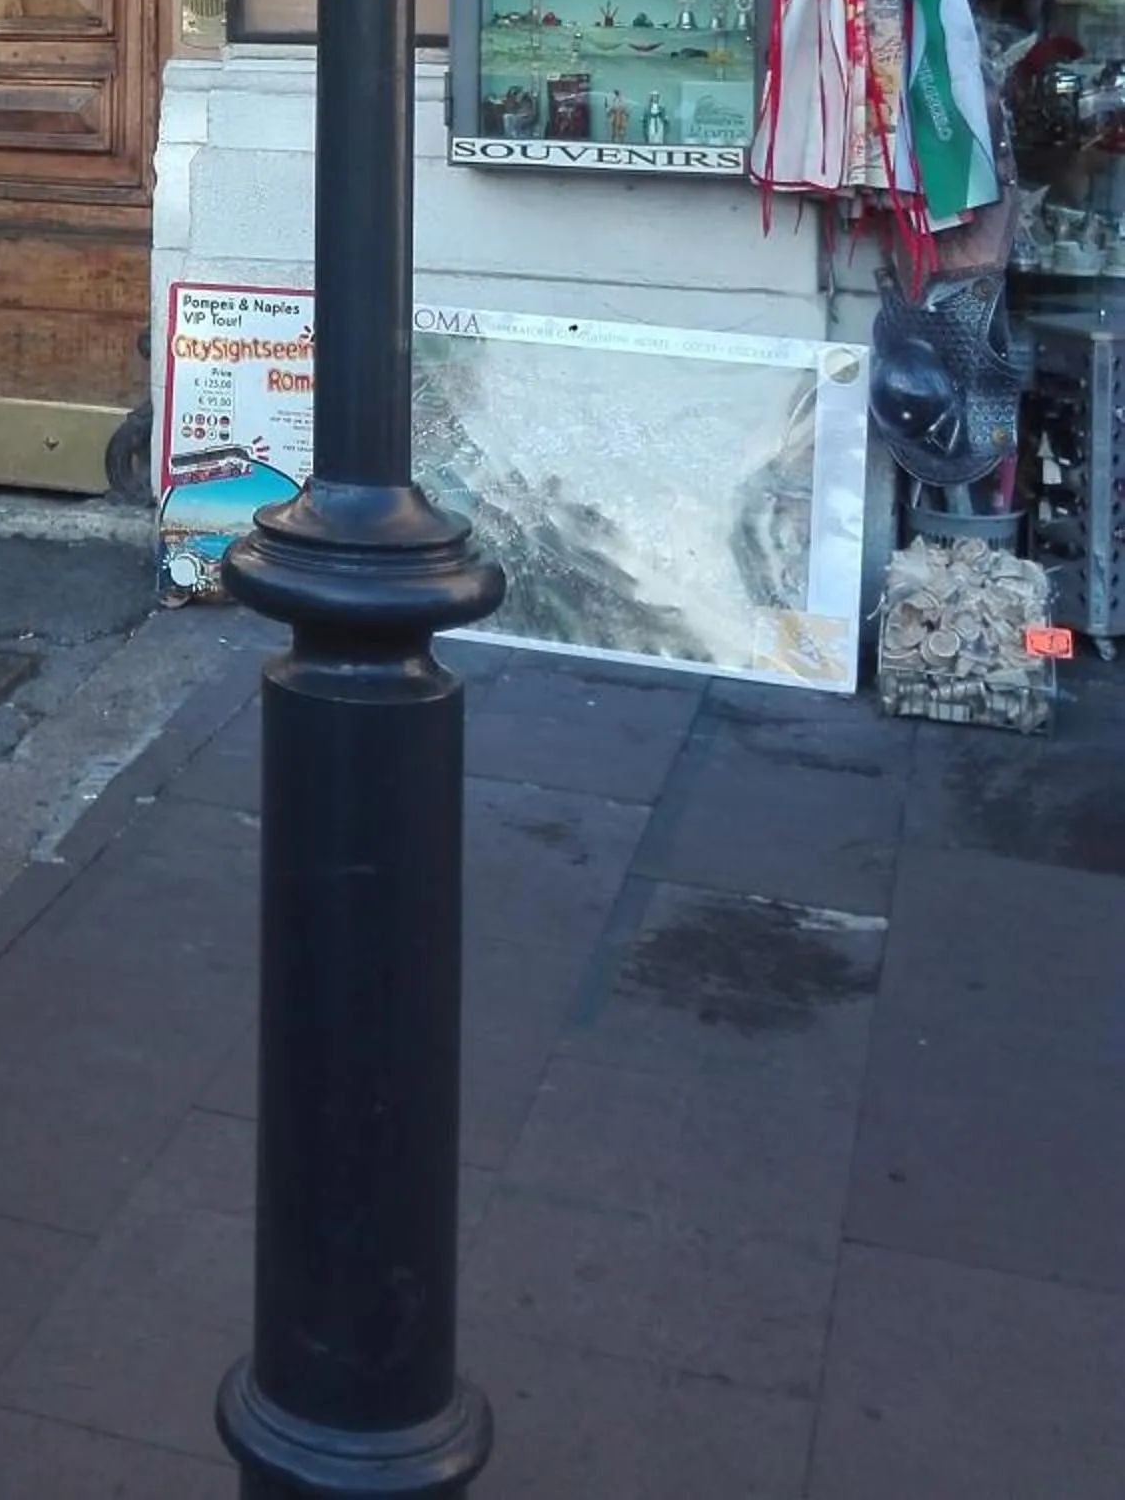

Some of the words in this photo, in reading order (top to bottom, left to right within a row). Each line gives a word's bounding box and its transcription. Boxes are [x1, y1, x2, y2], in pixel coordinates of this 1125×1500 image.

[453, 141, 742, 169] SOUVENIRS
[183, 294, 235, 314] Pompeii
[238, 298, 249, 311] &
[254, 299, 300, 316] Naples
[183, 311, 206, 324] VIP
[414, 308, 481, 335] OMA
[268, 368, 314, 392] Rom
